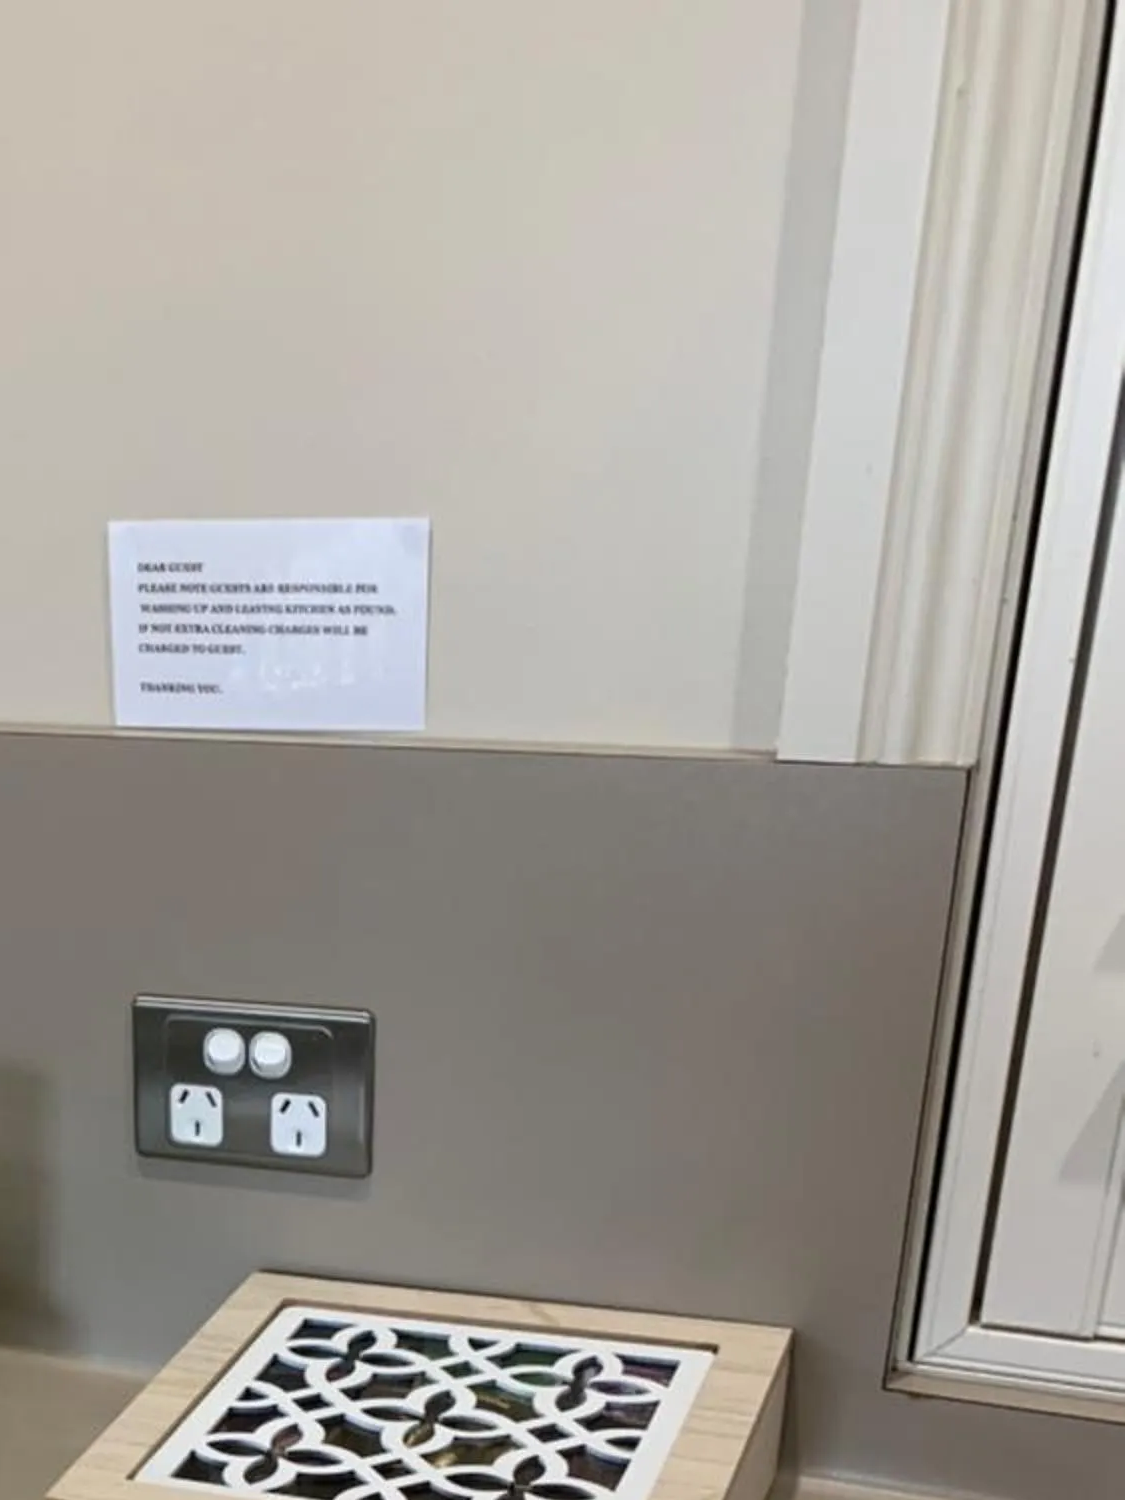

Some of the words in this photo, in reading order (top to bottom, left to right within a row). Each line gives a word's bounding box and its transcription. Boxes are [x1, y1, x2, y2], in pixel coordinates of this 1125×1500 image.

[137, 563, 165, 572] DEAR
[168, 563, 203, 572] GUEST
[138, 583, 176, 593] PLEASE
[180, 584, 206, 593] NOTE
[209, 584, 251, 593] GUESTS
[254, 584, 274, 593] ARE
[277, 583, 352, 593] RESPONSIBLE
[355, 583, 377, 593] FOR
[140, 604, 191, 613] WASHING
[194, 604, 208, 613] UP
[210, 604, 233, 613] AND
[235, 604, 283, 614] LEAVING
[285, 604, 334, 614] KITCHEN
[338, 605, 351, 614] AS
[138, 624, 148, 633] IF
[150, 624, 172, 633] NOT
[174, 624, 210, 634] EXTRA
[211, 624, 266, 635] CLEANING
[268, 625, 320, 635] CHARGES
[323, 625, 349, 635] WILL
[353, 625, 368, 636] BE
[138, 644, 190, 653] CHARGED
[192, 644, 206, 653] TO
[140, 682, 195, 693] THANKING
